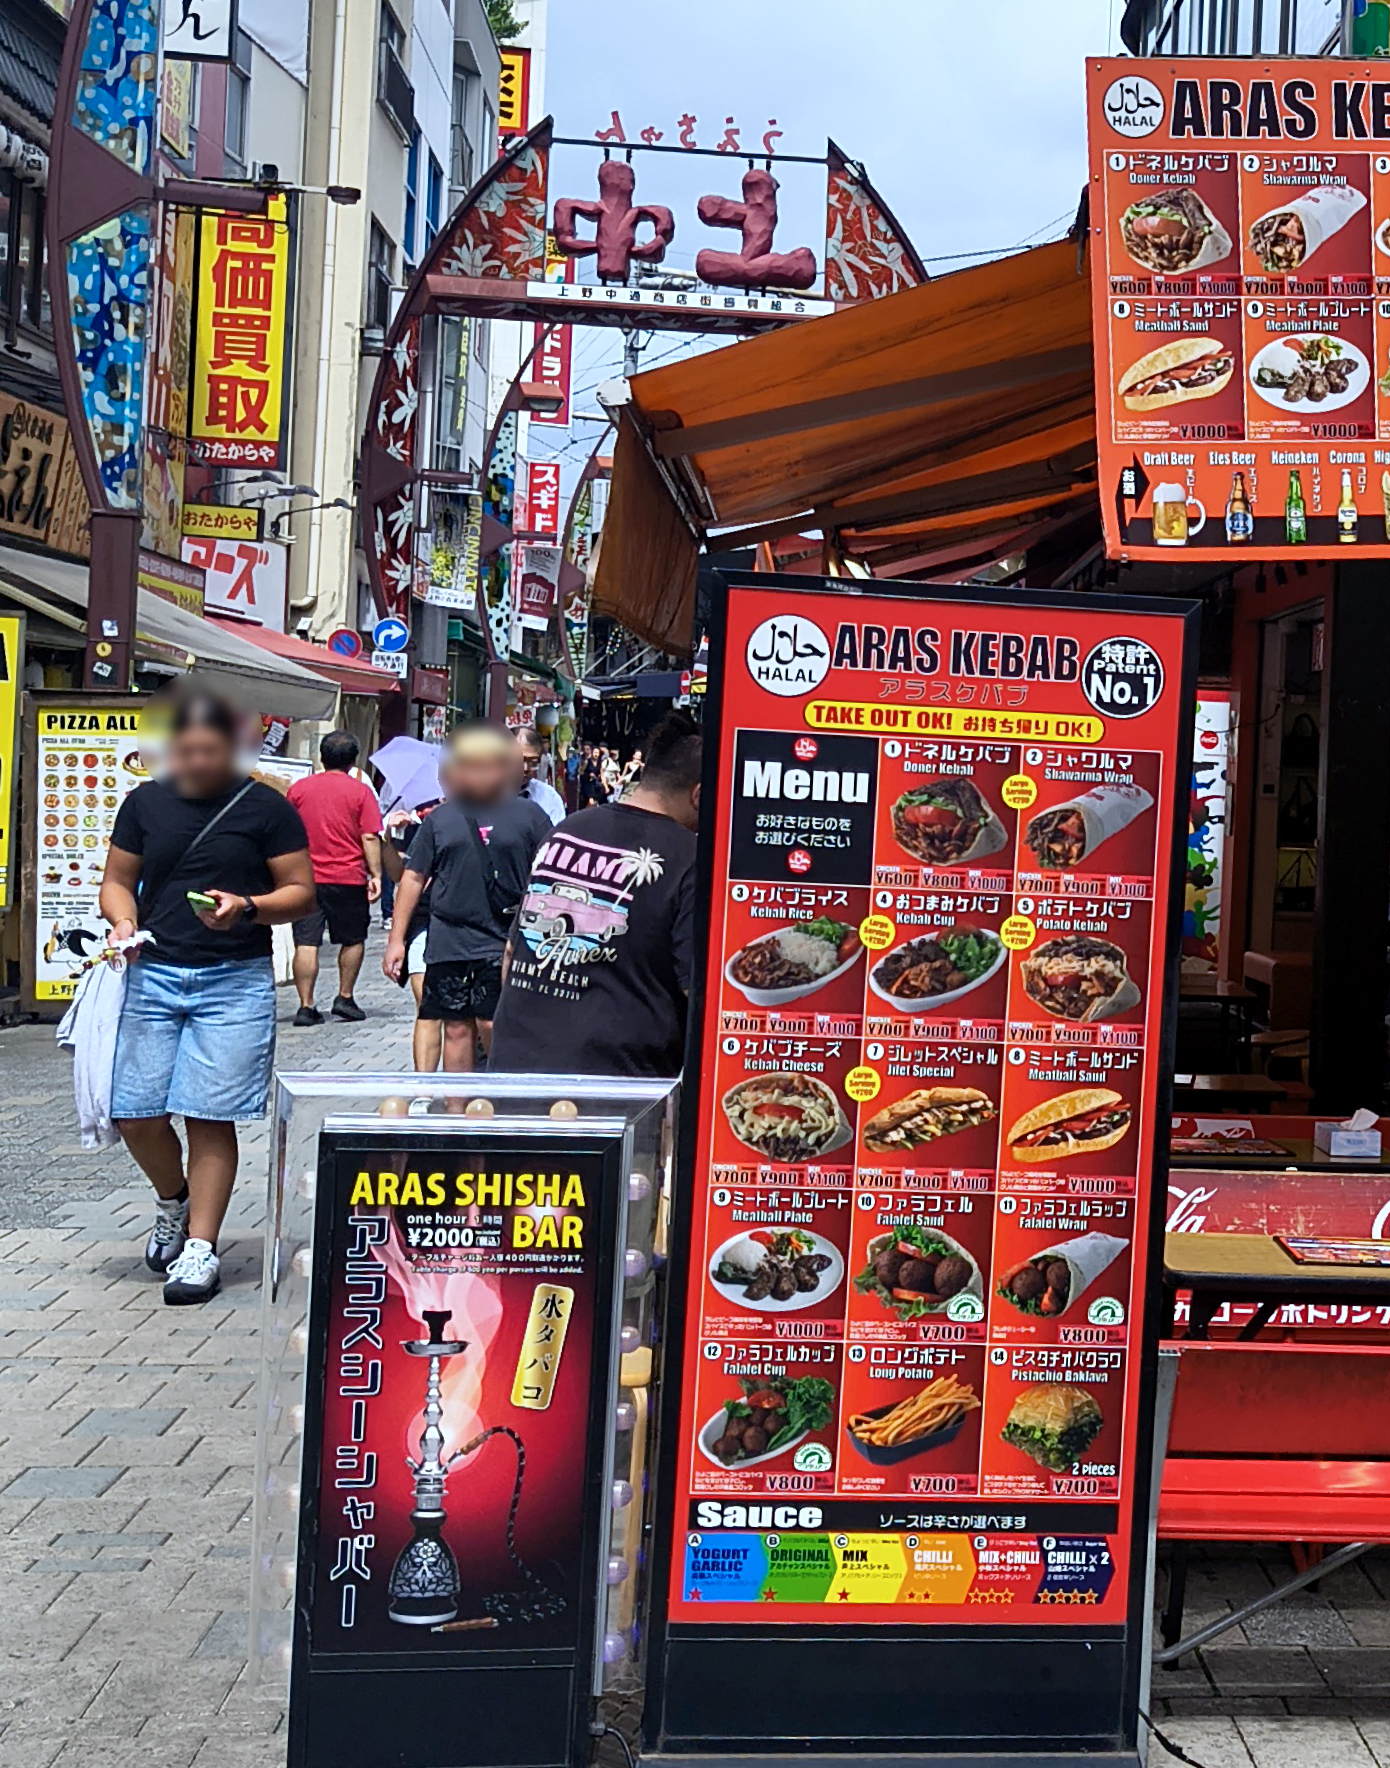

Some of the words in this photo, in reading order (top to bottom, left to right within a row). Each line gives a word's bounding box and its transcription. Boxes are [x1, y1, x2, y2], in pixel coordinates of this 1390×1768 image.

[1172, 78, 1317, 140] ARAS
[1112, 116, 1157, 128] HALAL
[1128, 154, 1230, 172] ドネルケバブ
[205, 209, 277, 436] 高価買取
[1170, 452, 1195, 466] Beer
[1271, 451, 1320, 465] Heineken
[1329, 450, 1366, 465] Corona
[183, 511, 258, 532] おたからや
[752, 622, 827, 662] حلال
[832, 622, 941, 675] ARAS
[949, 631, 1081, 683] KEBAB
[1100, 643, 1152, 662] 特許
[757, 666, 818, 685] HALAL
[1092, 659, 1157, 676] Patent
[878, 676, 1030, 707] アラスケバブ
[1089, 673, 1155, 707] No.1
[46, 714, 100, 732] PIZZA
[105, 715, 138, 731] ALL
[813, 704, 866, 727] TAKE
[870, 706, 914, 729] OUT
[916, 708, 953, 731] OK!
[962, 714, 1049, 736] お持ち帰り
[1055, 719, 1093, 739] OK!
[903, 742, 1013, 765] ドネルケバブ
[903, 761, 935, 776] Doner
[937, 762, 974, 777] Kebab
[741, 759, 870, 804] Menu
[755, 813, 853, 833] お好きなものを
[754, 830, 852, 850] お選びください
[751, 887, 849, 907] ケバブライス
[895, 893, 1000, 914] おつまみケバブ
[1036, 899, 1132, 919] ポテトケバブ
[1036, 917, 1072, 932] Potato
[1073, 918, 1108, 933] Kebab
[550, 968, 590, 988] BEACH
[742, 1039, 842, 1059] ケバブチーズ
[887, 1045, 999, 1066] ジレットスペシャル
[1028, 1050, 1139, 1070] ミートボールサンド
[1028, 1068, 1077, 1082] Meatball
[1079, 1069, 1107, 1083] Sand
[350, 1172, 446, 1206] ARAS
[455, 1172, 586, 1207] SHISHA
[1069, 1177, 1116, 1195] ¥1000
[731, 1190, 849, 1210] ミートボールプレート
[878, 1194, 973, 1214] ファラフェル
[1018, 1197, 1127, 1217] ファラフェルラップ
[406, 1214, 433, 1225] one
[435, 1213, 468, 1225] hour
[407, 1227, 474, 1248] ¥2000
[512, 1215, 584, 1249] BAR
[1062, 1326, 1107, 1344] ¥800
[522, 1293, 565, 1401] 水タバコ
[723, 1344, 836, 1364] ファラフェルカップ
[868, 1346, 966, 1367] ロングポテト
[1010, 1349, 1121, 1369] ピスタチオバクラワ
[1011, 1367, 1064, 1383] Pistachio
[1065, 1369, 1109, 1384] Baklava
[330, 1214, 389, 1629] アラスシーシャバー
[1071, 1461, 1080, 1476] 2
[1081, 1462, 1116, 1478] pieces
[766, 1473, 814, 1491] ¥800
[1051, 1478, 1098, 1496] ¥700
[697, 1501, 823, 1530] Sauce
[692, 1548, 750, 1561] YOGURT
[770, 1549, 831, 1563] ORIGINAL
[842, 1549, 868, 1563] MIX
[913, 1550, 954, 1564] CHILLI
[978, 1550, 1041, 1565] MIX+CHILLI
[691, 1560, 743, 1573] GARLIC
